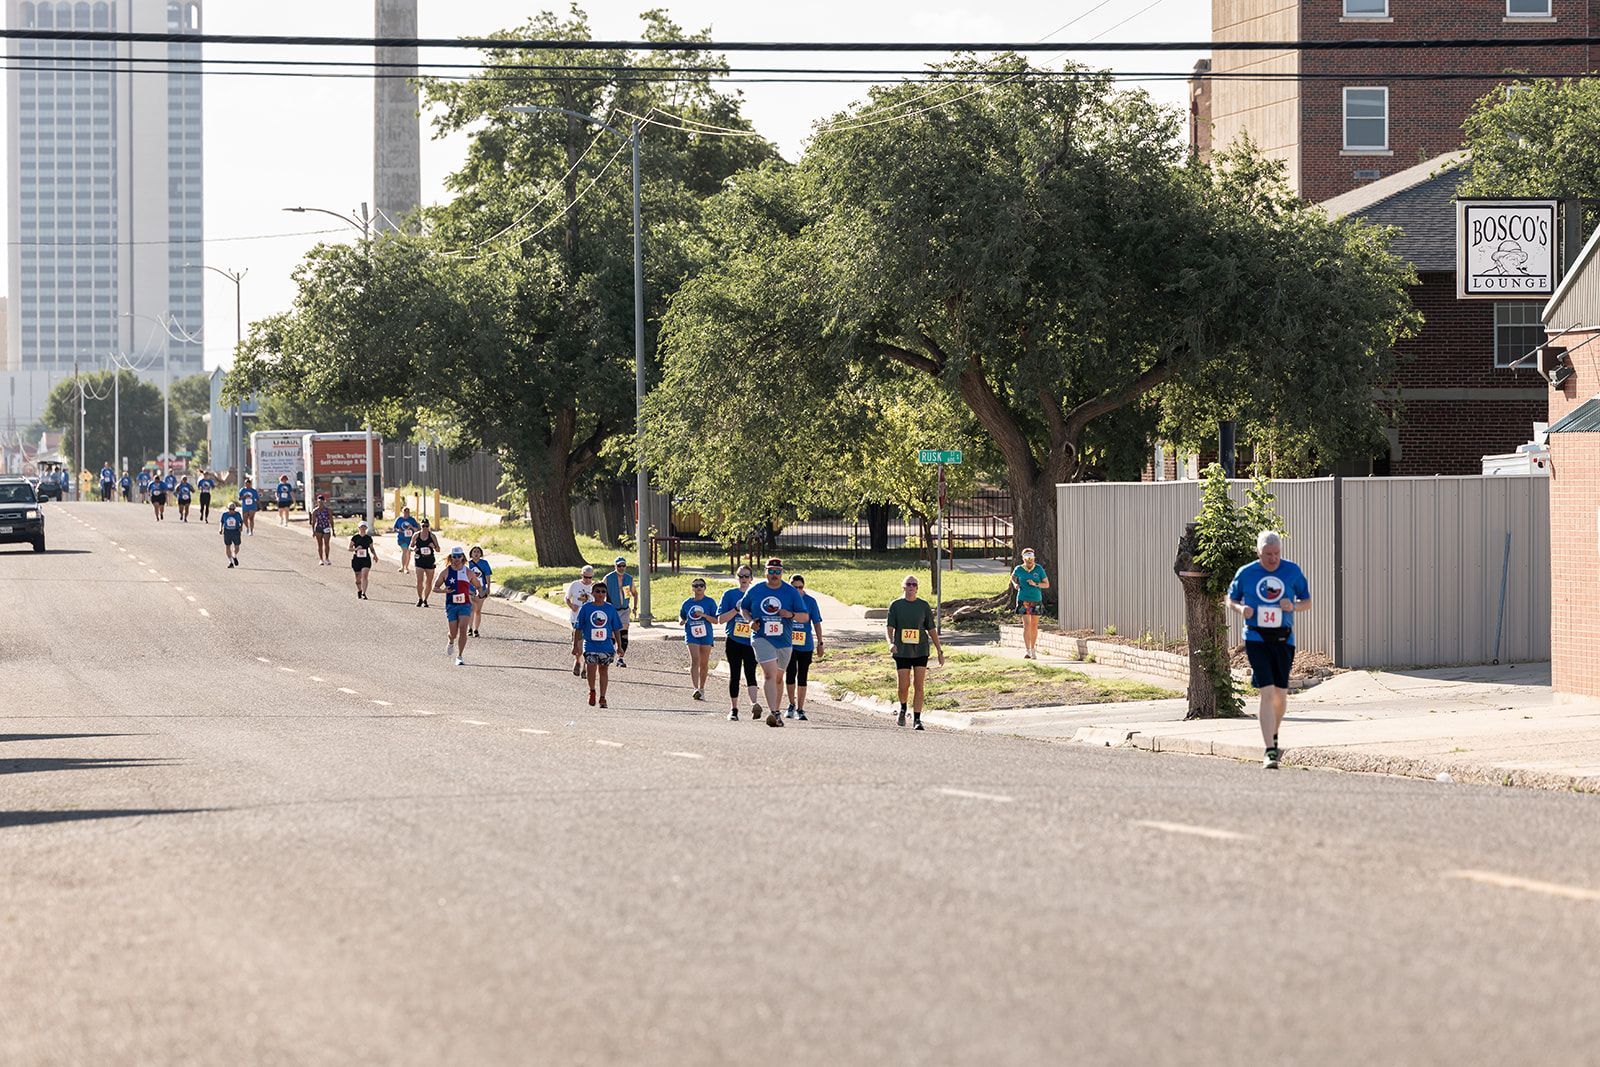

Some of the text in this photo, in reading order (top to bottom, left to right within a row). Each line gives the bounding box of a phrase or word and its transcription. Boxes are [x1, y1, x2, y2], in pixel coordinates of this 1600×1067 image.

[1472, 214, 1548, 247] BOSCO'S
[1473, 278, 1547, 288] LOUNGE
[921, 451, 942, 462] RUSK
[1263, 611, 1276, 623] 34
[736, 623, 750, 633] 373
[769, 624, 779, 633] 36
[904, 630, 917, 639] 371
